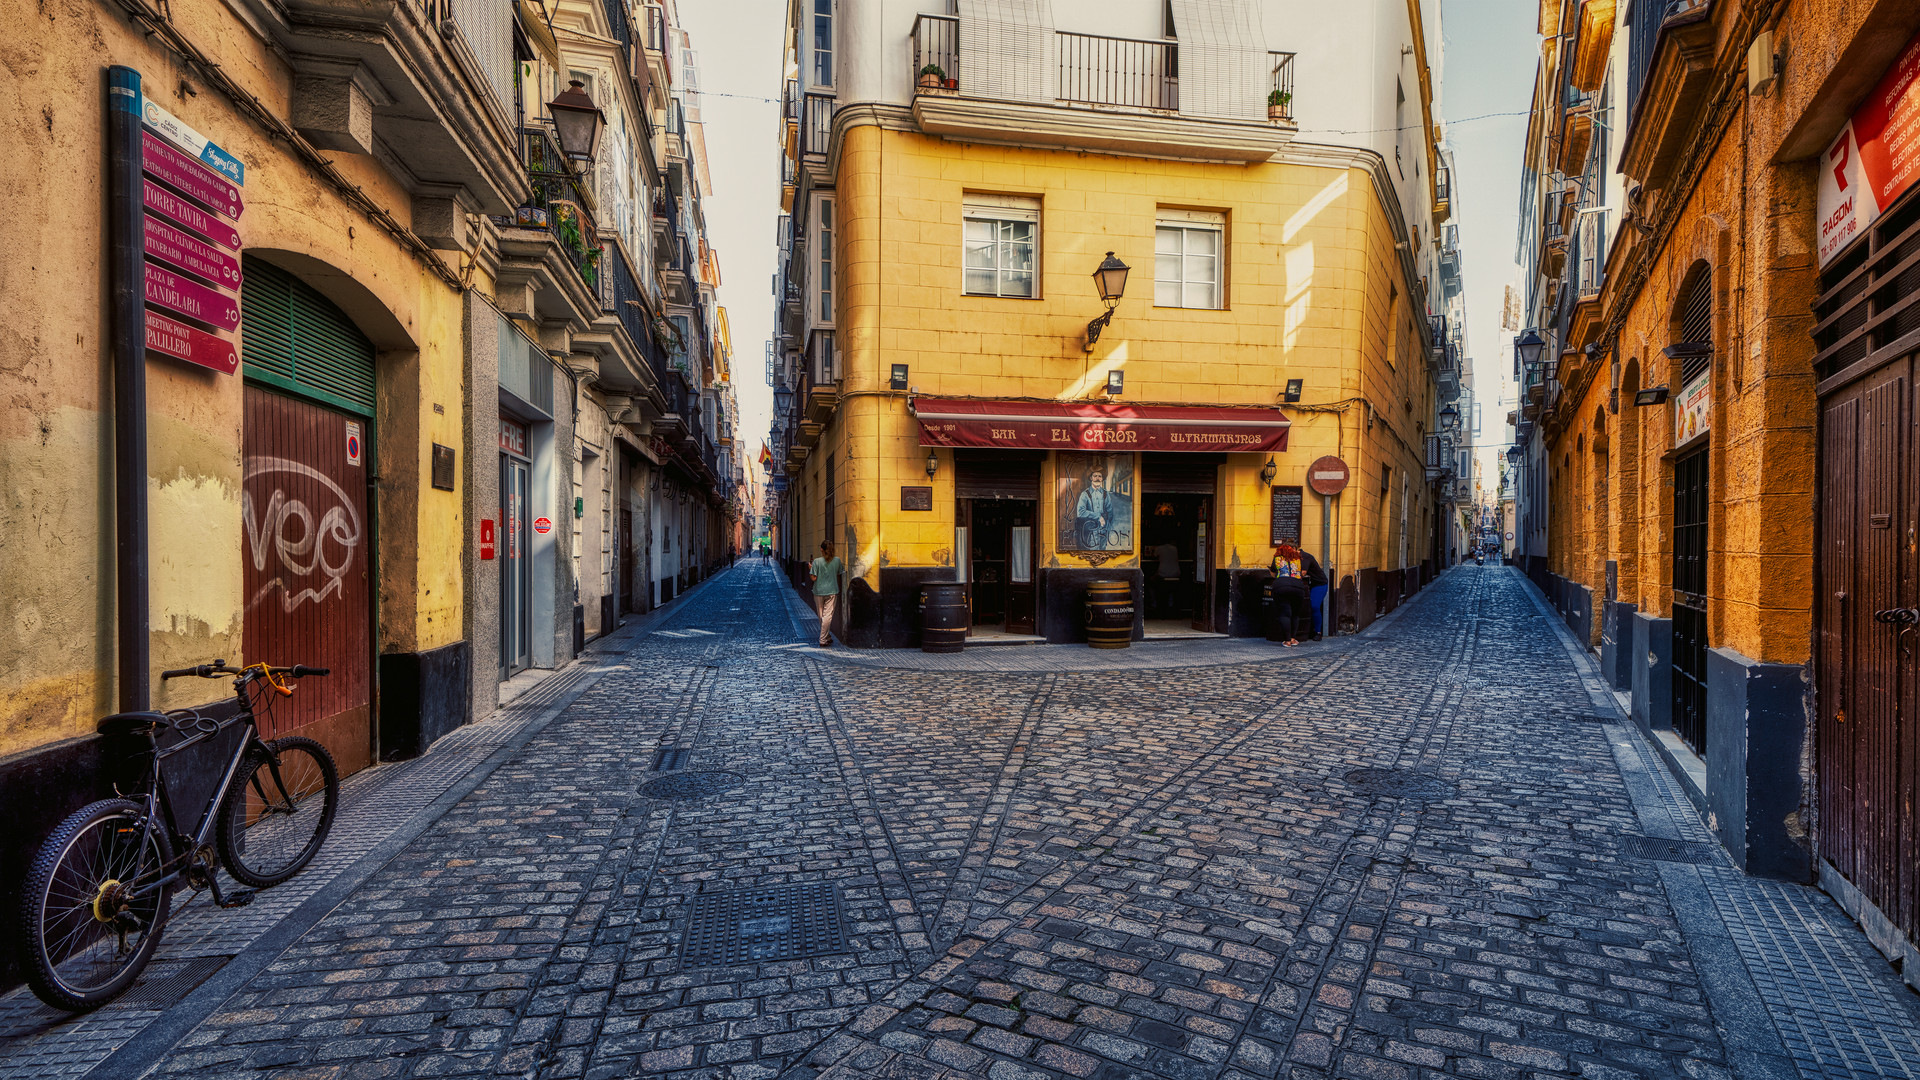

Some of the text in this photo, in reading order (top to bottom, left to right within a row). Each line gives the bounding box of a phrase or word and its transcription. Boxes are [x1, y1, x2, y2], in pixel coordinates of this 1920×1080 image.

[1899, 43, 1920, 73] PINTUR
[1885, 68, 1913, 108] REFORMAS
[1883, 99, 1919, 144] CERRADURAS
[1889, 92, 1908, 121] LLAVES
[1890, 130, 1907, 155] REDES
[163, 168, 174, 181] DEL
[173, 175, 192, 193] TÍTERE
[193, 186, 200, 196] LA
[1883, 162, 1912, 196] CENTRALES
[145, 185, 208, 231] TORRE TAVIRA
[1822, 195, 1853, 238] RAGOM
[145, 220, 224, 265] HOSPITAL CLÍNICA LA SALUD
[1838, 226, 1847, 243] 117
[145, 236, 220, 278] ITINERARIO AMBULANCIA
[145, 267, 175, 288] PLAZA DE
[146, 281, 201, 315] CANDELARIA
[146, 315, 190, 340] MEETING POINT
[147, 328, 192, 356] PALILLERO
[991, 427, 1262, 444] BAR EL CAÑON ULTRAMARINOS
